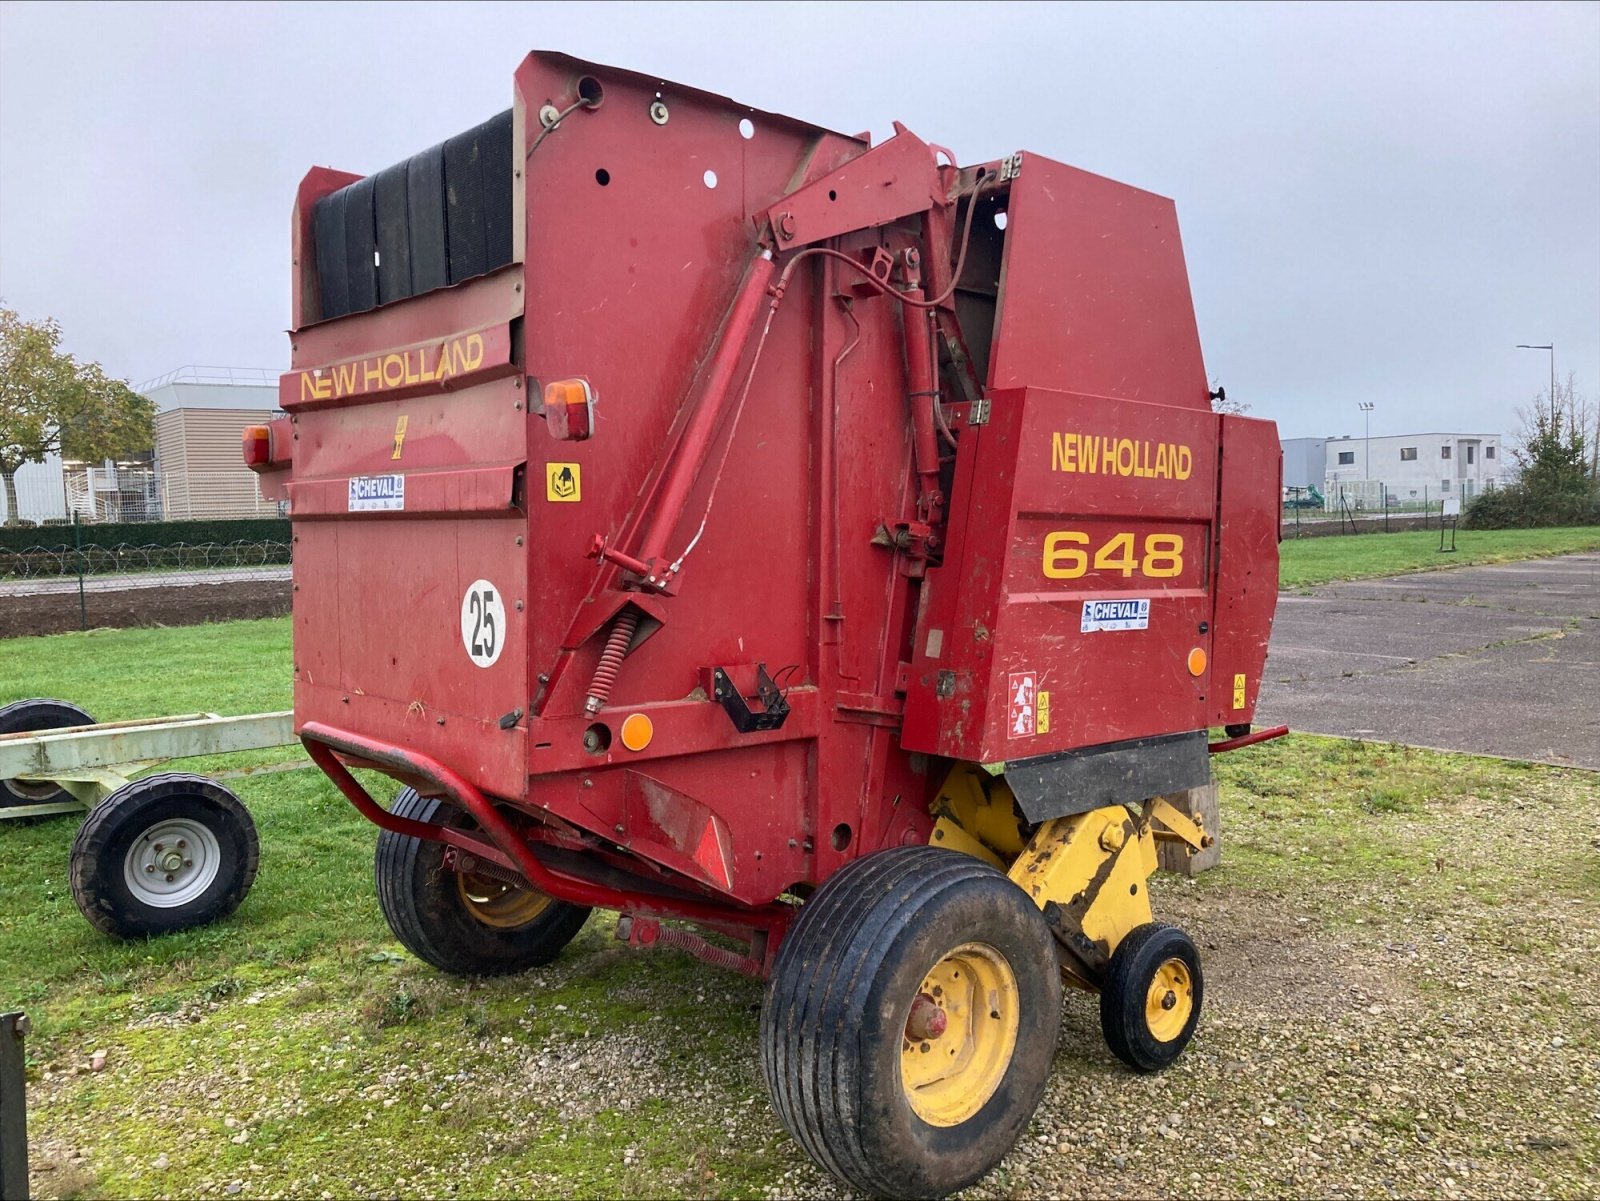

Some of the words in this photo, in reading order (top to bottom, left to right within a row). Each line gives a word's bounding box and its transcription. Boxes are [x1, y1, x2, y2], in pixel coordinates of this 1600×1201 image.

[301, 363, 357, 401] NEW
[364, 333, 484, 392] HOLLAND
[1052, 432, 1100, 474] NEW
[1102, 437, 1192, 481] HOLLAND
[358, 478, 395, 498] CHEVAL
[1042, 531, 1184, 579] 648
[470, 590, 496, 658] 25
[1094, 602, 1138, 619] CHEVAL
